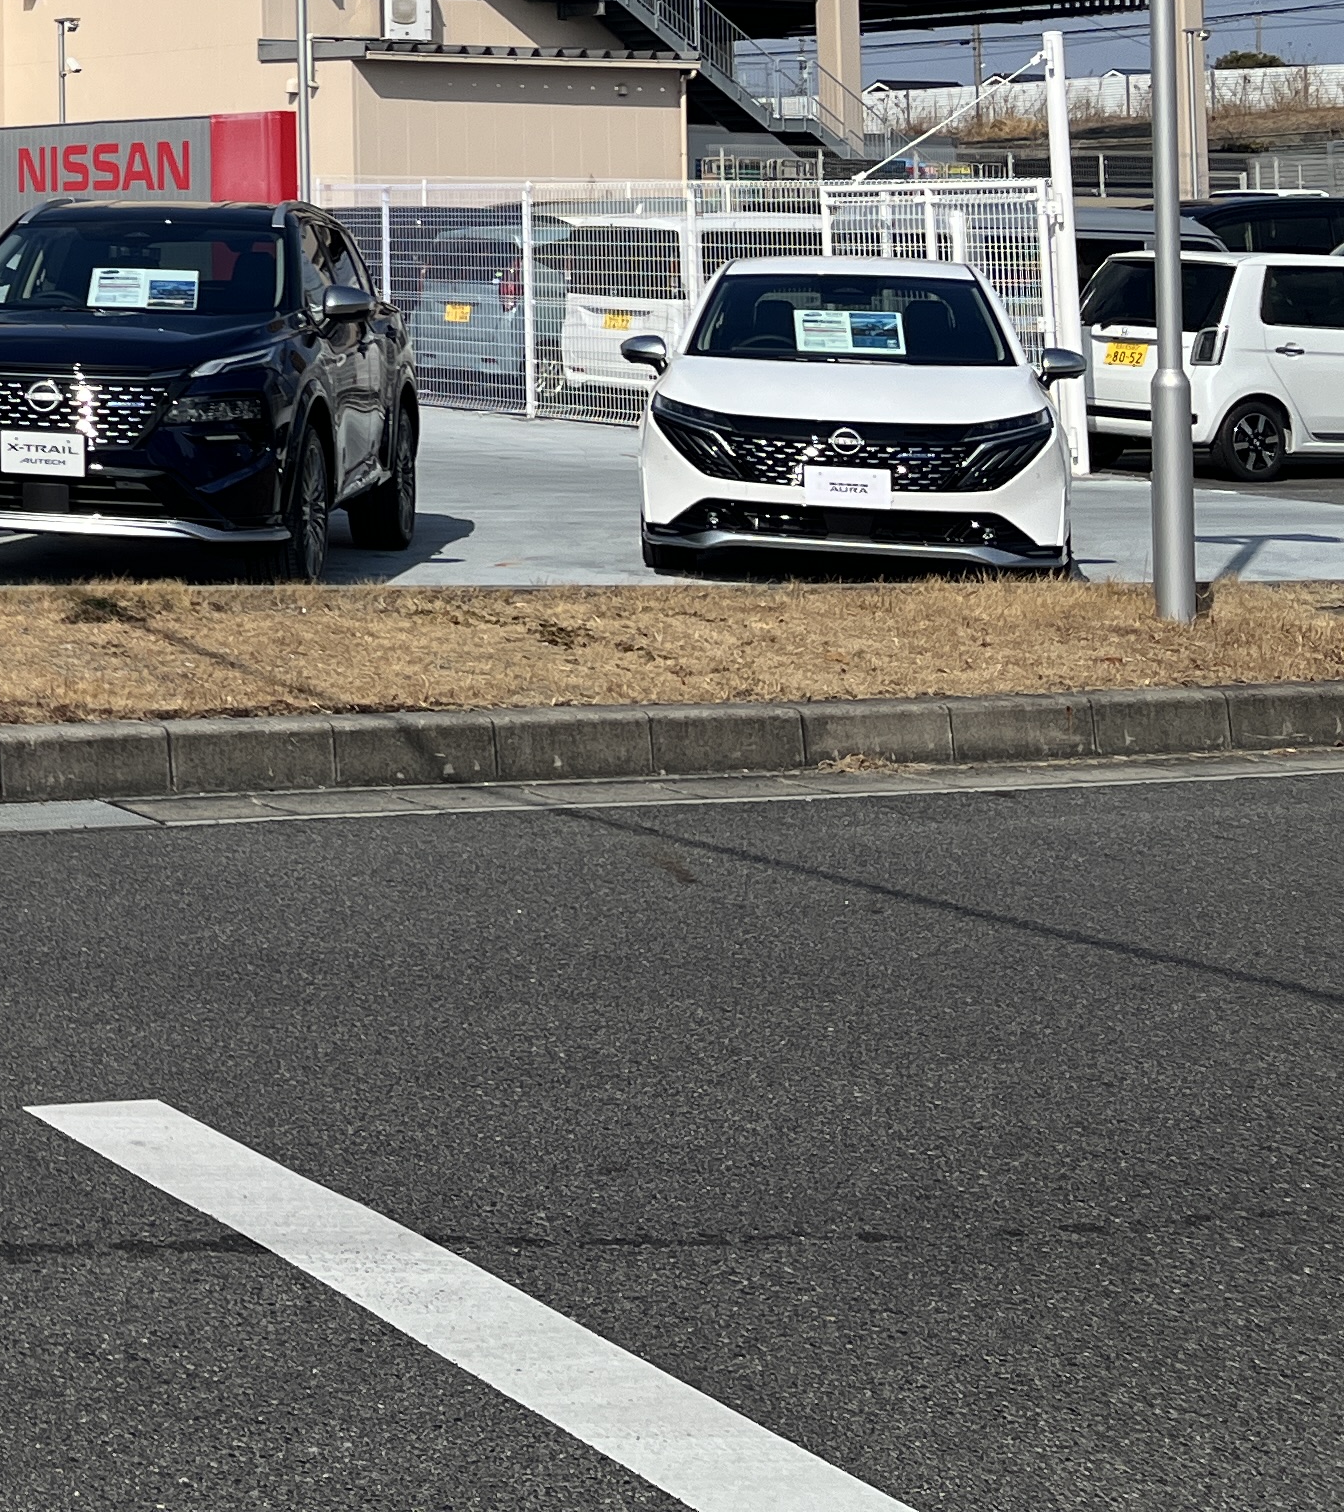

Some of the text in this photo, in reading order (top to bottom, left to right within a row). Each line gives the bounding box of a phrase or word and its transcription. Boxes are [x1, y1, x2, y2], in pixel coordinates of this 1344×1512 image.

[18, 141, 190, 192] NISSAN
[7, 442, 80, 456] X-TRAIL
[20, 457, 66, 466] AUTECH
[829, 485, 869, 494] AURA
